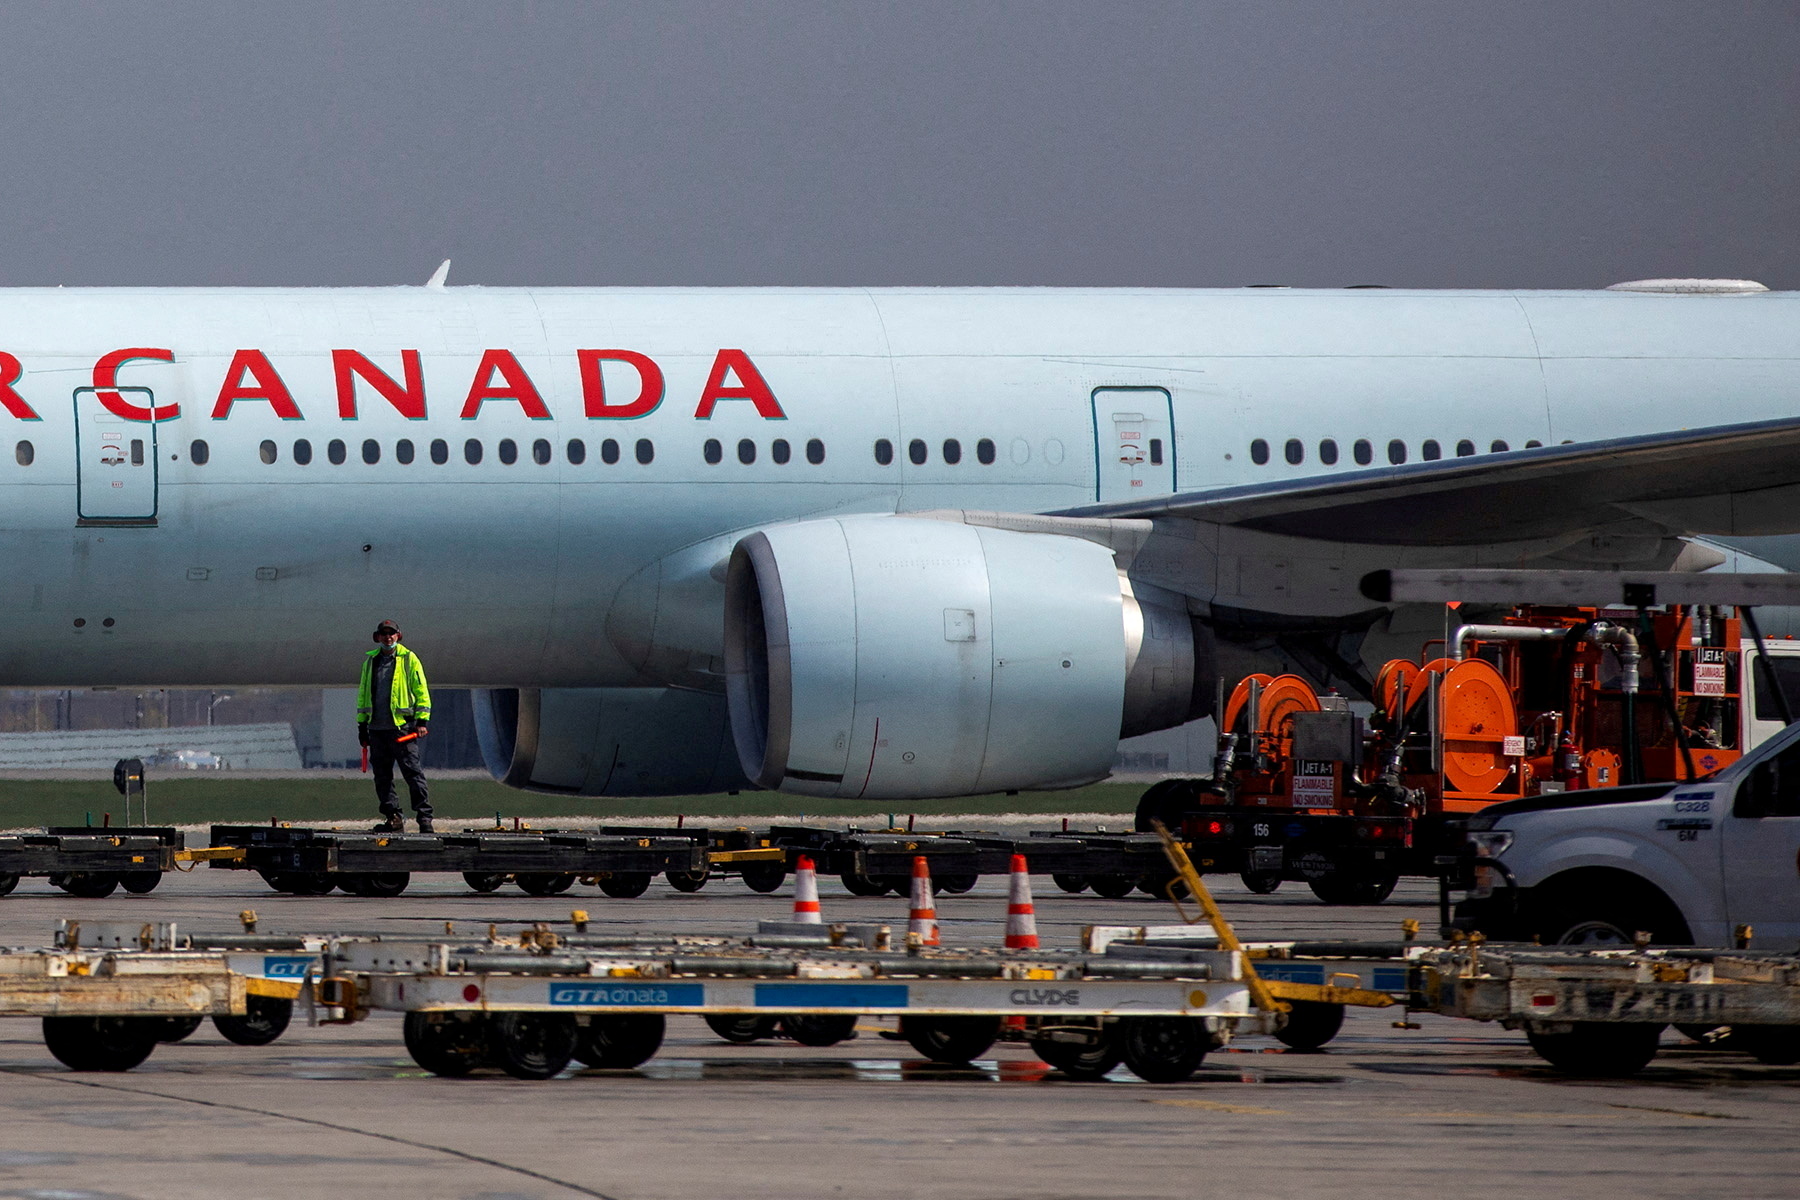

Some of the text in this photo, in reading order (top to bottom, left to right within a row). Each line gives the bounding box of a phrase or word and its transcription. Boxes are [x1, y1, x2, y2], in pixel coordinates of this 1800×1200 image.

[93, 347, 788, 422] CANADA
[1305, 762, 1333, 774] JET A-1
[1294, 778, 1333, 790] FLAMMABLE
[1294, 794, 1333, 806] NO SMOKING
[1675, 801, 1710, 812] C328
[1253, 823, 1269, 836] 156
[554, 987, 668, 1003] GTA dnata
[1009, 989, 1080, 1005] CLYDE
